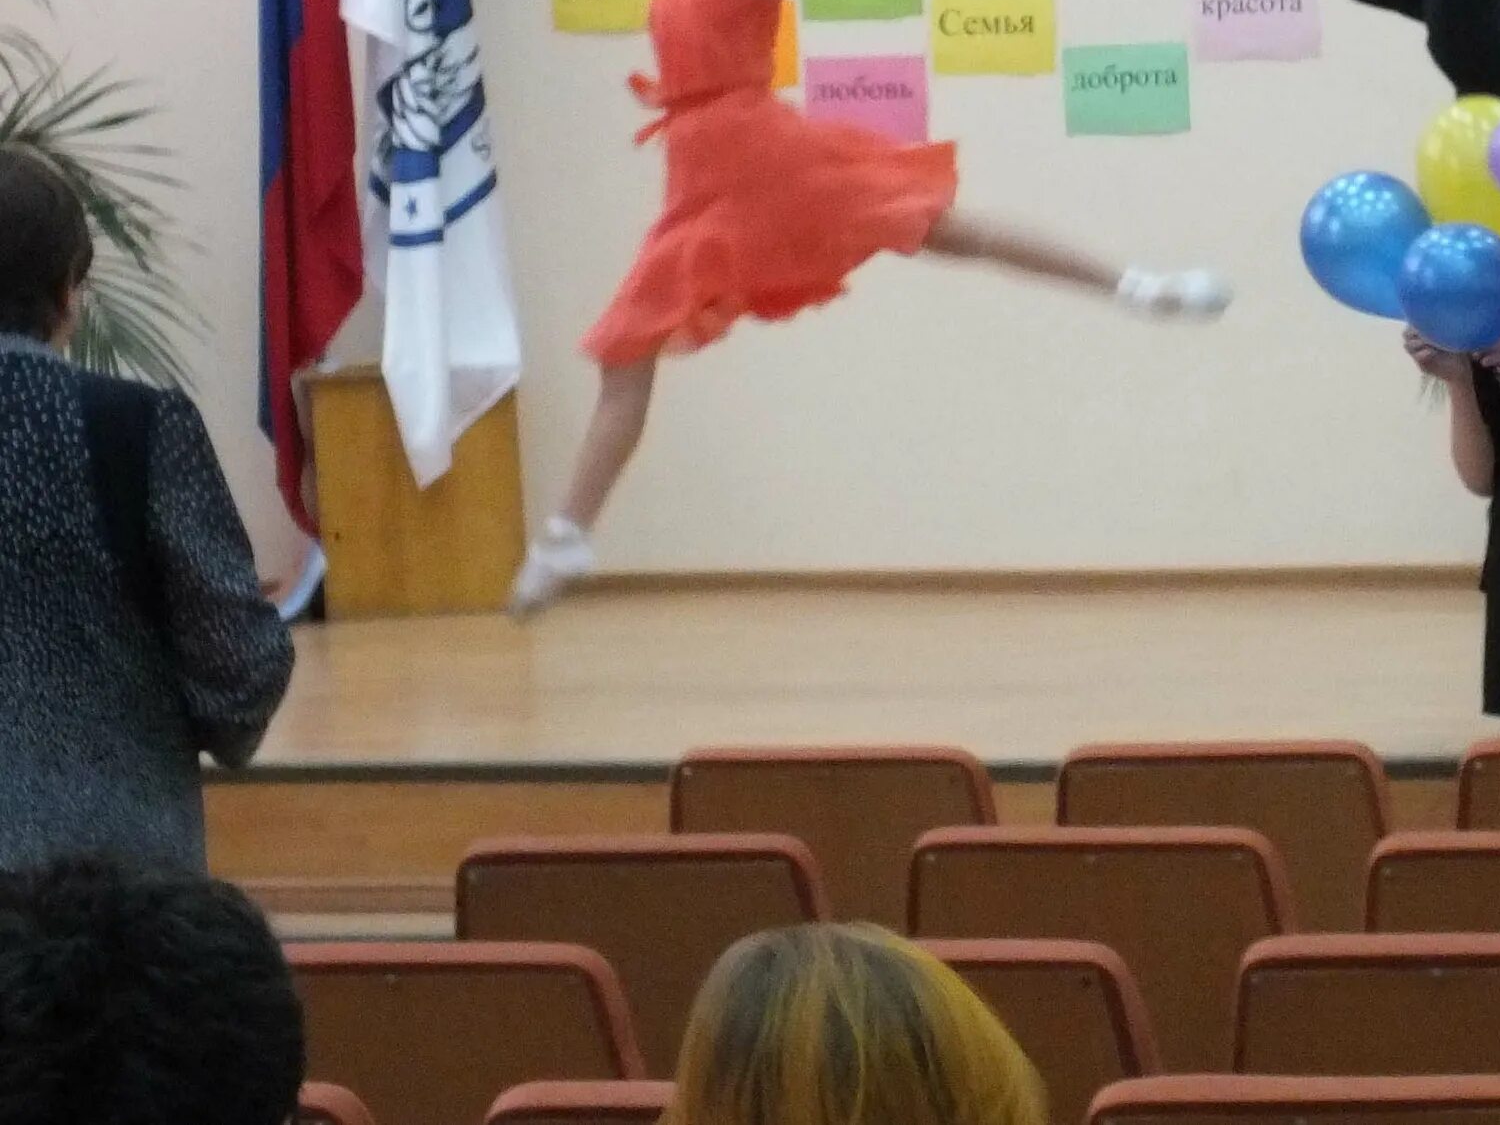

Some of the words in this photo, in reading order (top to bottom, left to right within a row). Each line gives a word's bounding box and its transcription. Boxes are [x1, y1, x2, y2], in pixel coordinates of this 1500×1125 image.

[938, 7, 1035, 36] Семья
[813, 75, 915, 103] любовь
[1070, 63, 1178, 94] доброта
